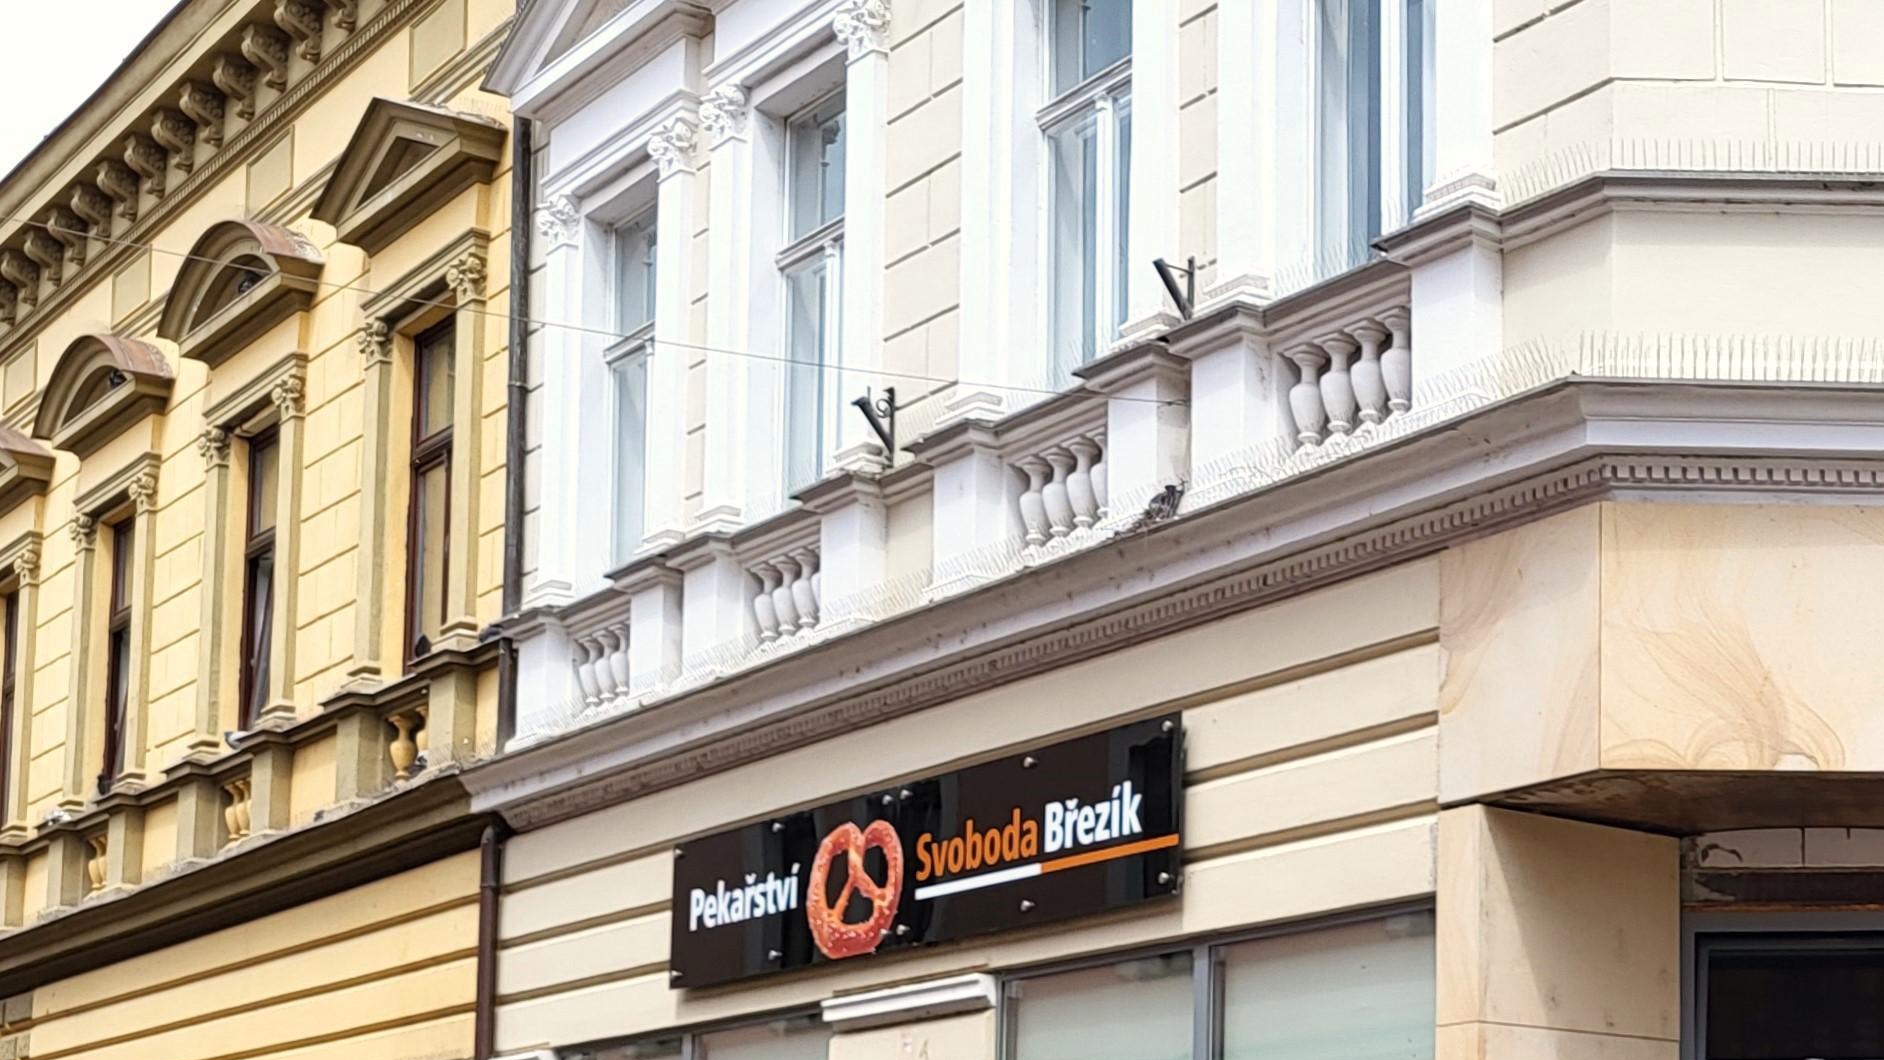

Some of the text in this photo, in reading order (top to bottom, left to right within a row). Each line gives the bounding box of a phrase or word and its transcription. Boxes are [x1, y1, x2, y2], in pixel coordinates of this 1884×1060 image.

[915, 780, 1143, 881] Svoboda Březík
[689, 864, 801, 931] Pekařství
